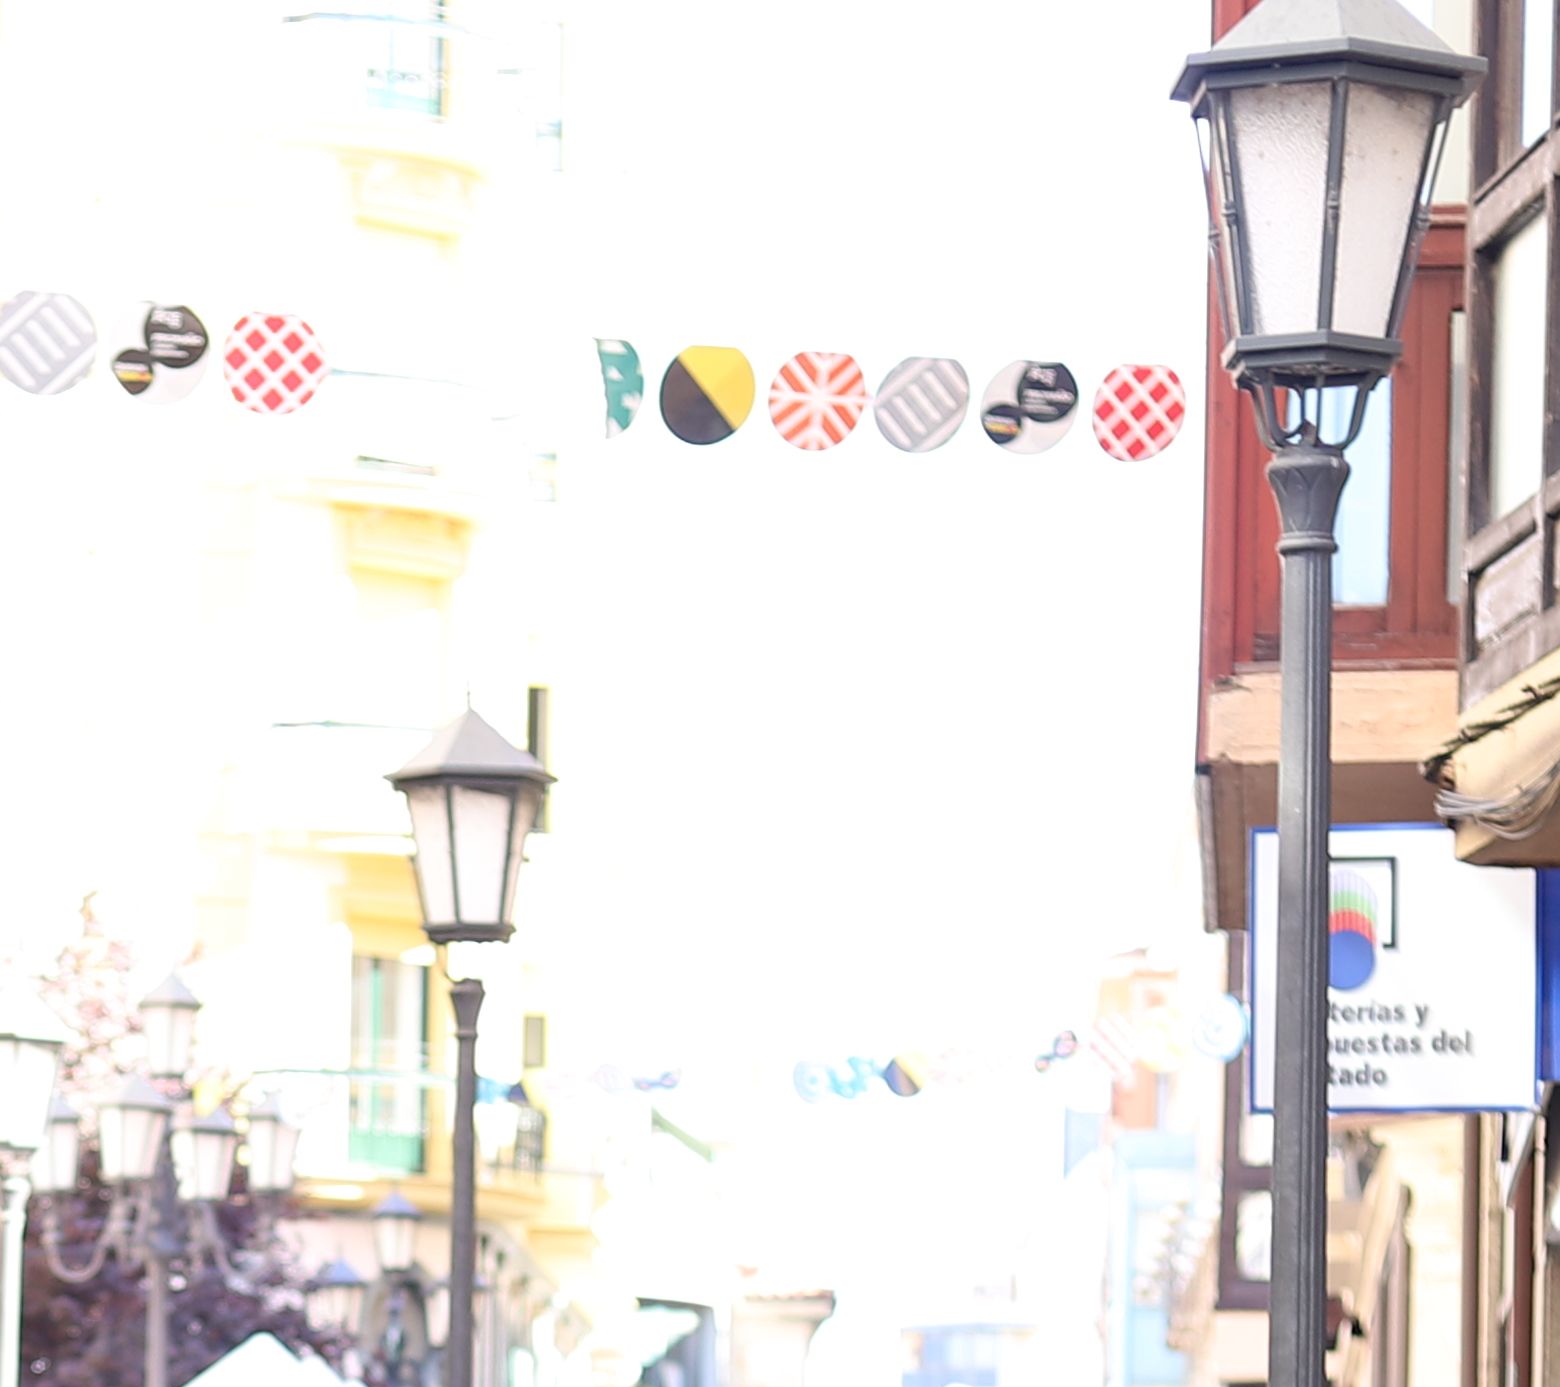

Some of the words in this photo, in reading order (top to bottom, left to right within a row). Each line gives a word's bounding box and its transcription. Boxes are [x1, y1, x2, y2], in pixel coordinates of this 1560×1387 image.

[1329, 1000, 1406, 1024] terías
[1415, 1002, 1430, 1030] y
[1329, 1033, 1422, 1057] uestas
[1431, 1029, 1475, 1055] del
[1329, 1063, 1388, 1086] tado
